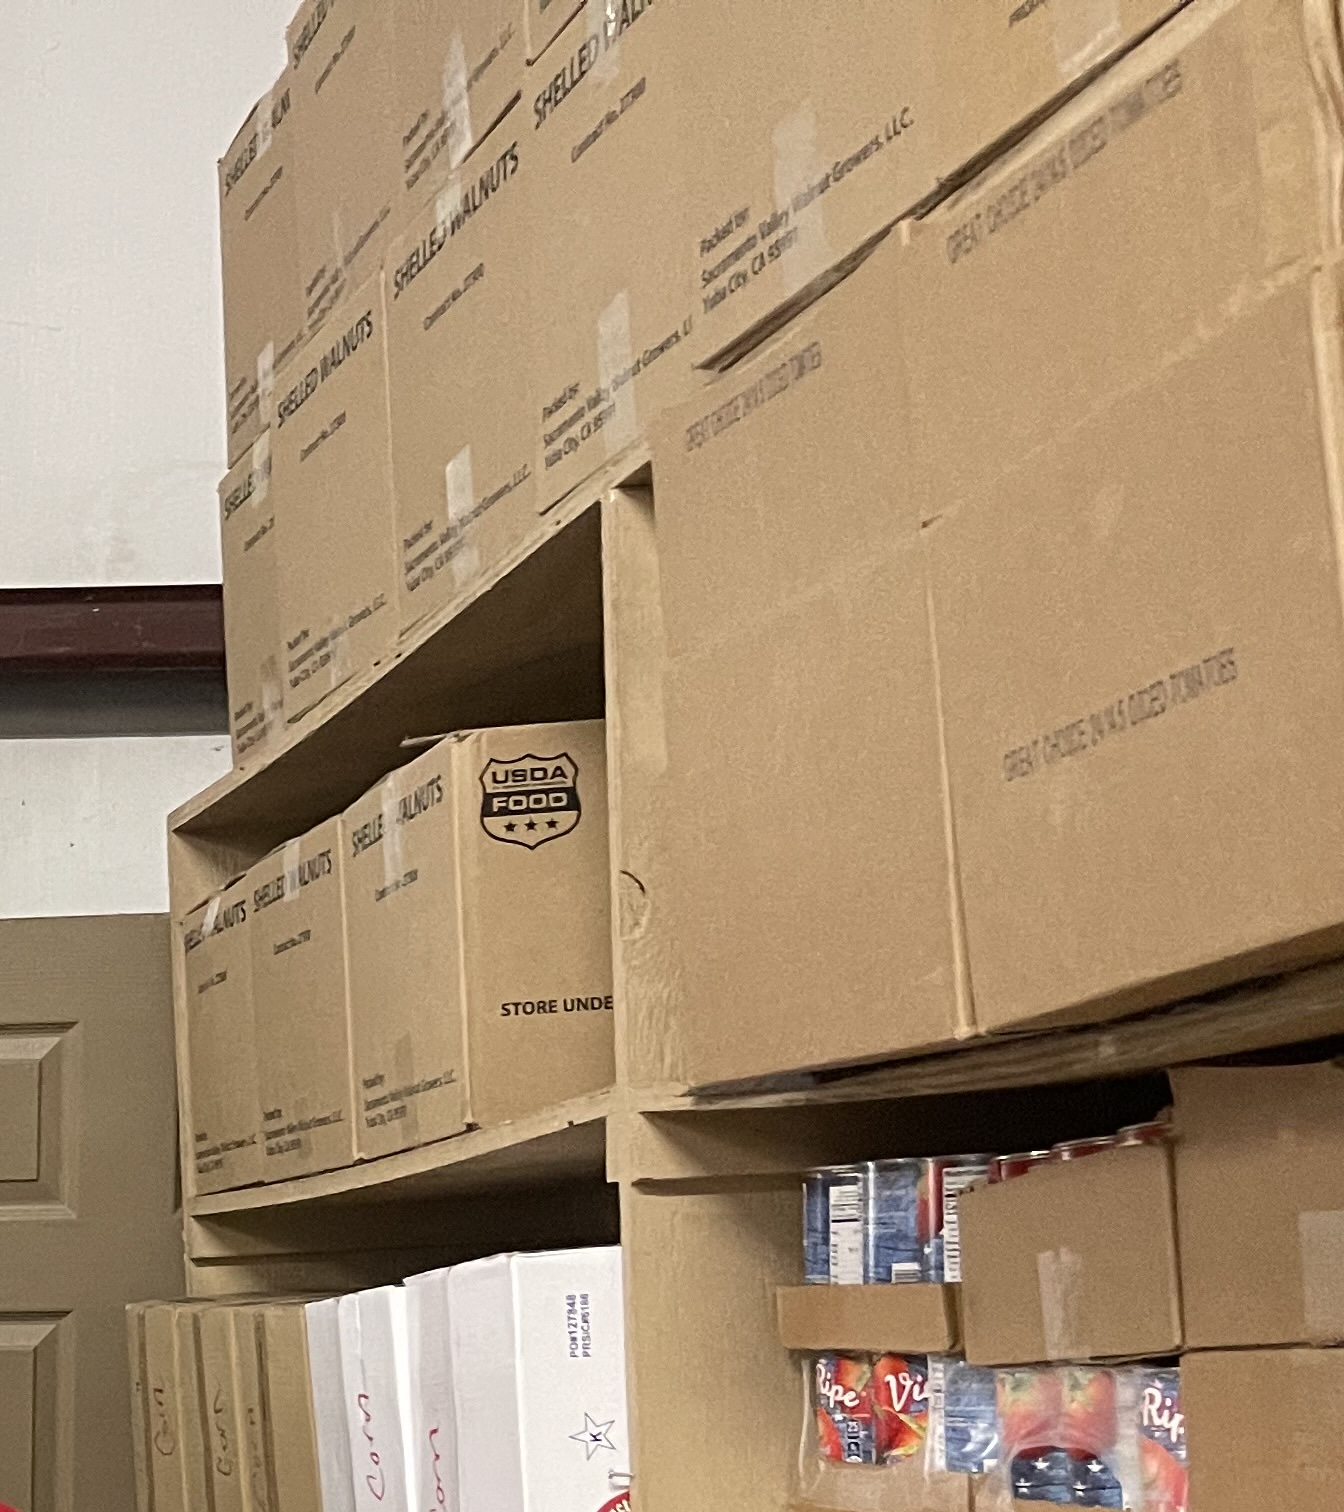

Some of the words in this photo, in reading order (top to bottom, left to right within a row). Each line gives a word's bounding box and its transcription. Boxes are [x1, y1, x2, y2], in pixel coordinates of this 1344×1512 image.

[490, 763, 570, 786] USDA
[490, 791, 570, 812] FOOD
[500, 998, 559, 1018] STORE
